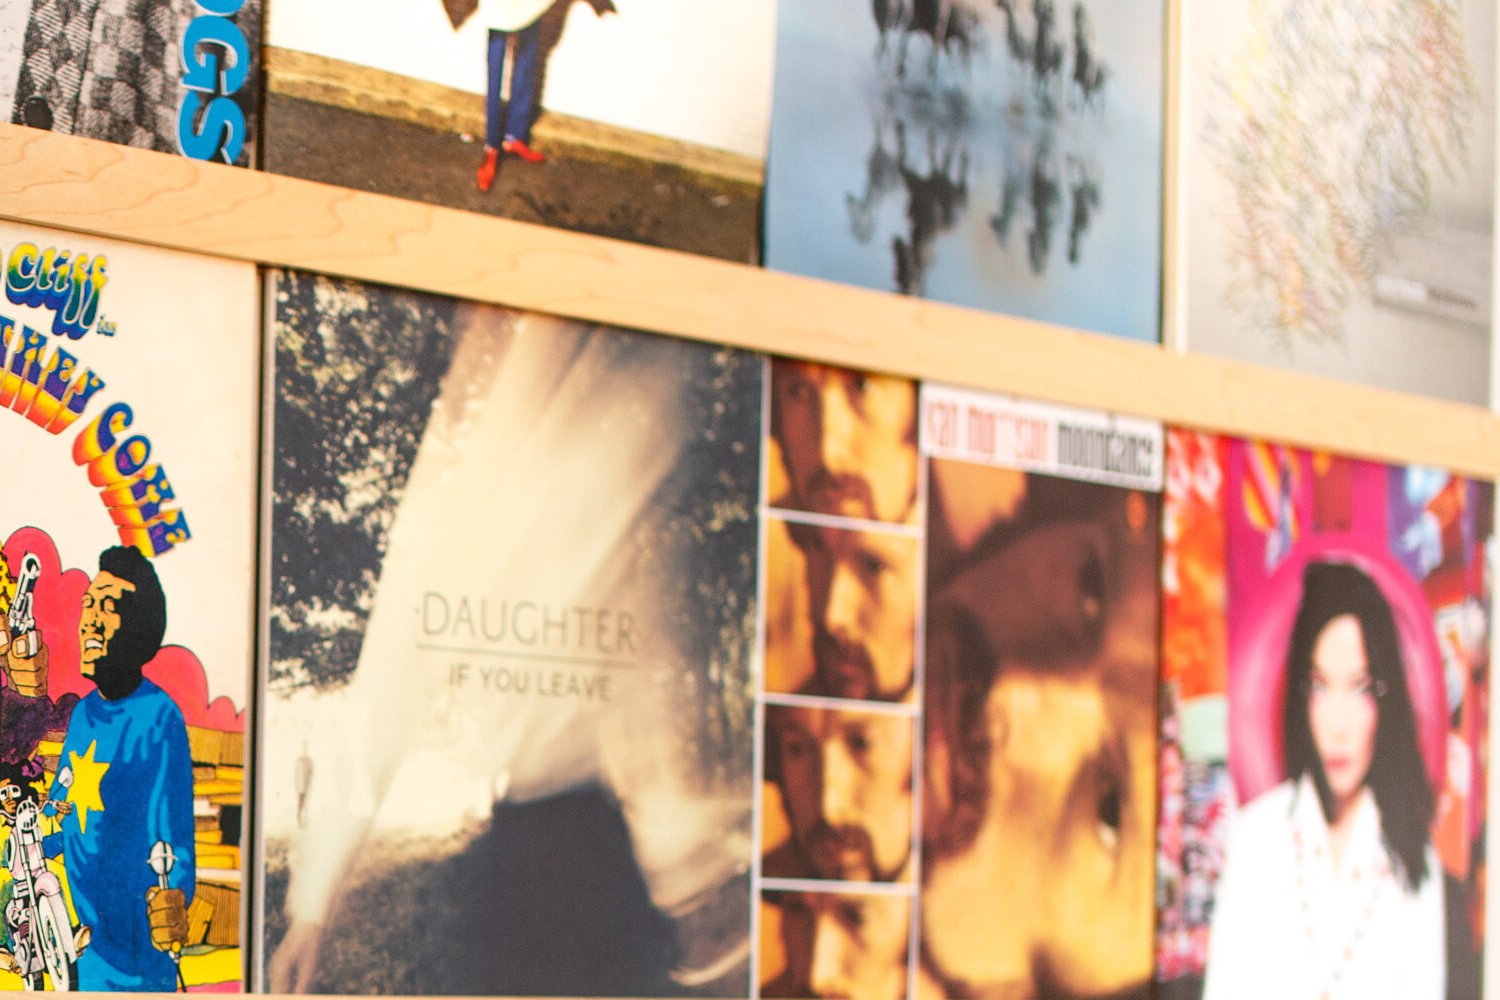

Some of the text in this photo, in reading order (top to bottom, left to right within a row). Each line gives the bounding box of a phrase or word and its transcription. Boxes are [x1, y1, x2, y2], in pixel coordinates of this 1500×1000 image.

[4, 241, 108, 341] Cliff
[72, 402, 192, 557] COME
[421, 590, 637, 654] DAUGHTER
[450, 661, 612, 701] IF YOU LEAVE
